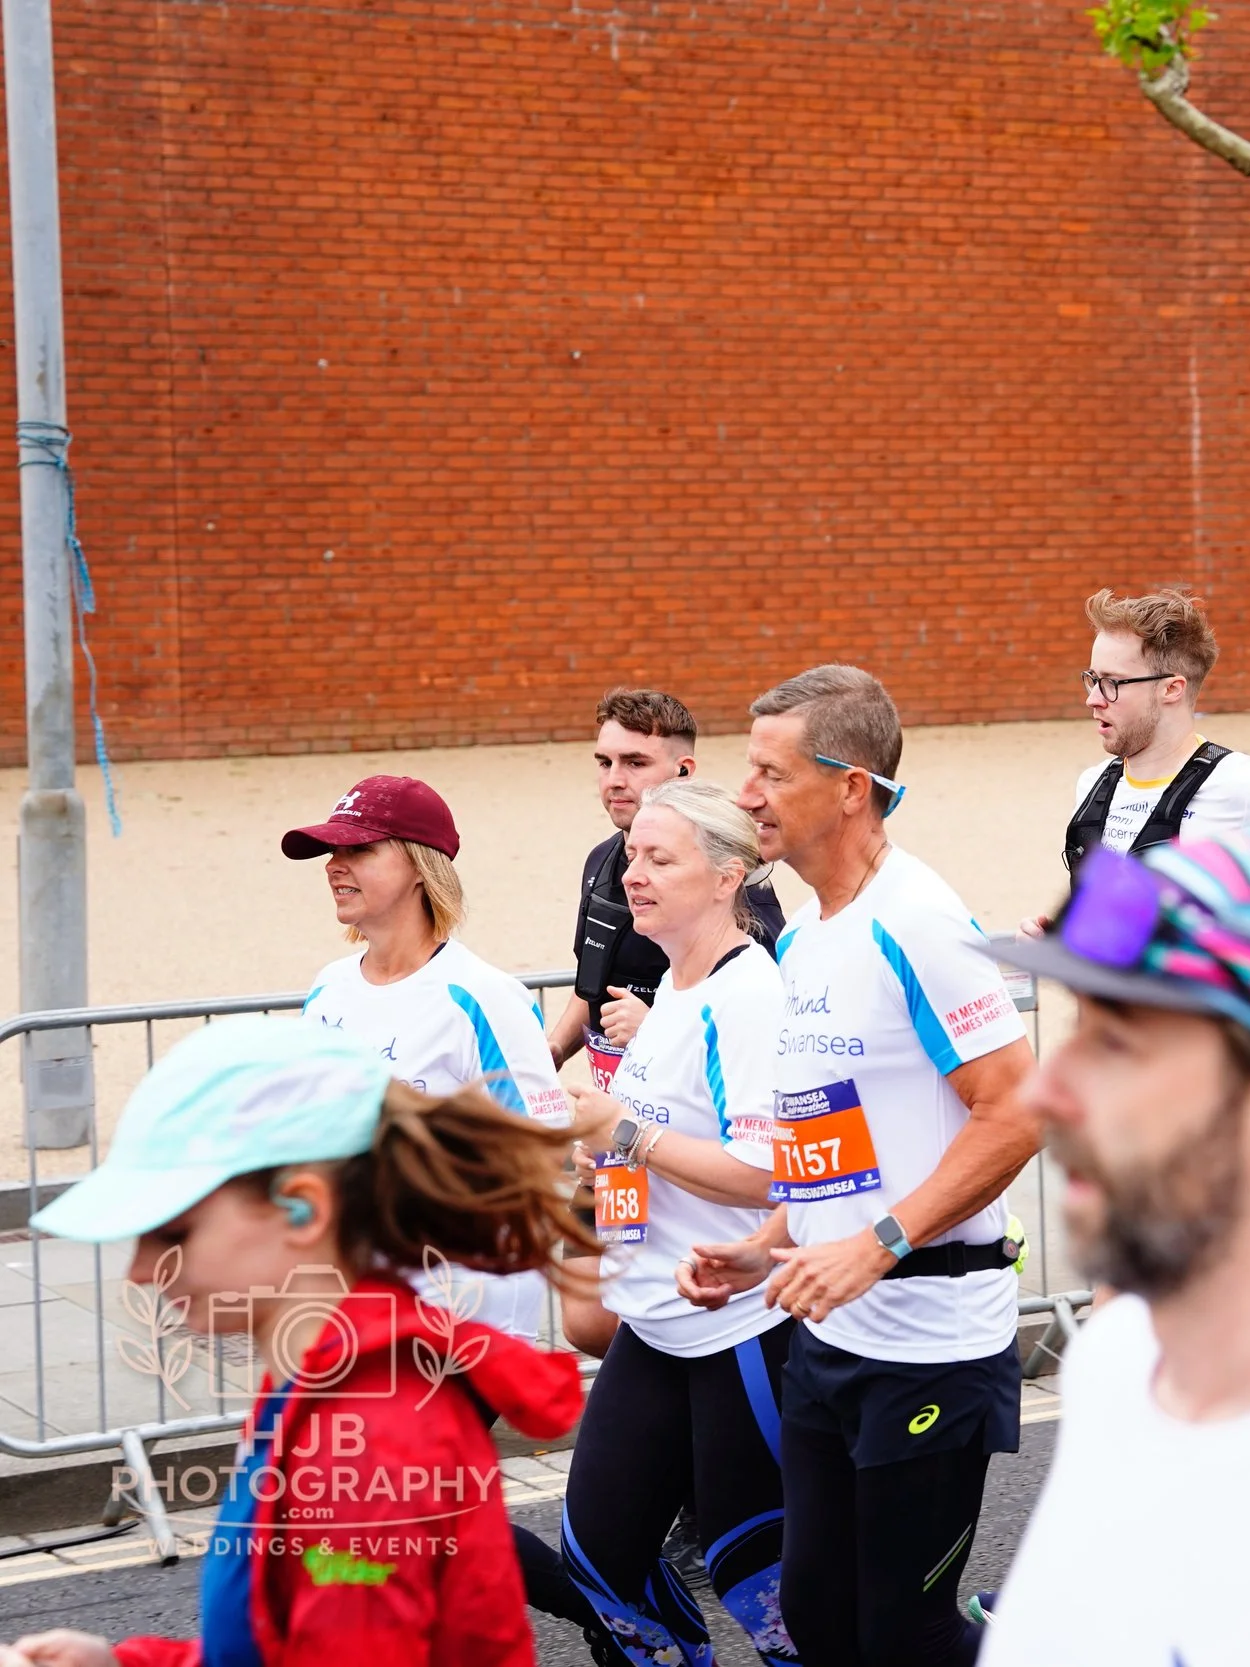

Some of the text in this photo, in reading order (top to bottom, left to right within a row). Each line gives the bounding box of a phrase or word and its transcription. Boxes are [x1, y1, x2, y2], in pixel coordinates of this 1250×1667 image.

[945, 1011, 959, 1027] IN
[952, 1015, 983, 1039] JAMES
[777, 1028, 864, 1056] Swansea
[781, 1137, 841, 1177] 7157
[601, 1187, 640, 1221] 7158
